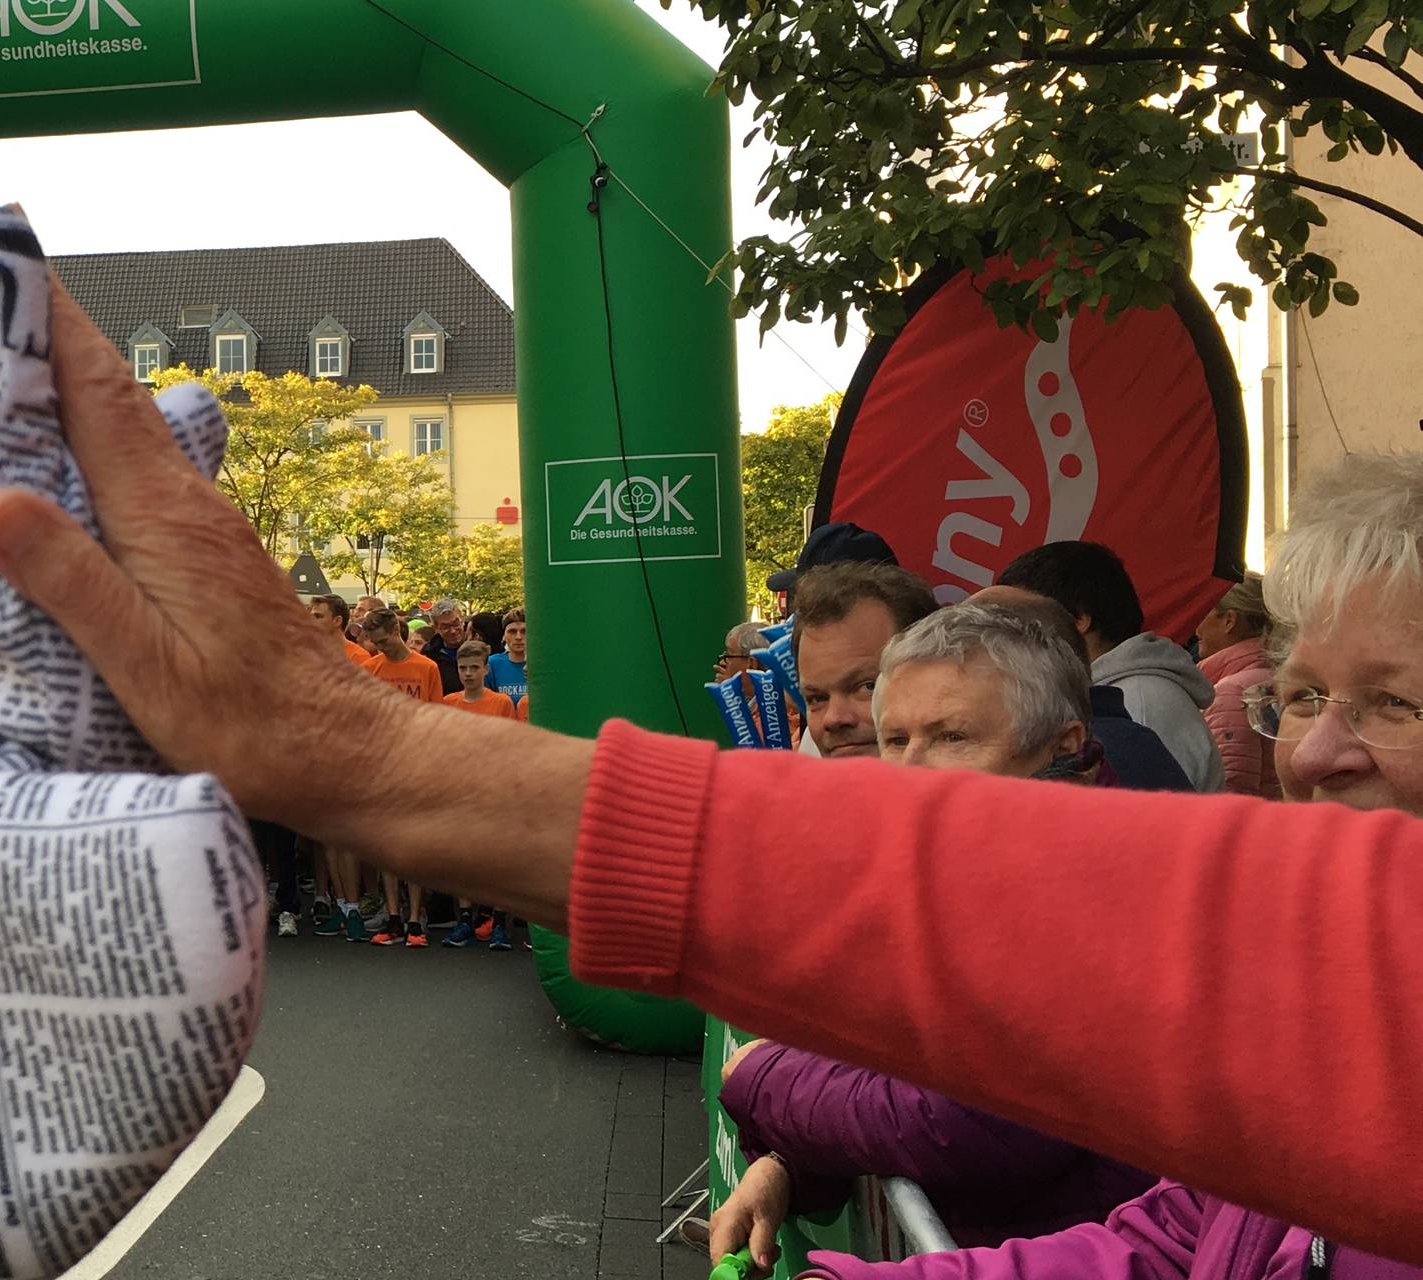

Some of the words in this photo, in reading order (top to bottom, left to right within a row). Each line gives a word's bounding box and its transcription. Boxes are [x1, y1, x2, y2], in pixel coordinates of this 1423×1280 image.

[573, 474, 695, 526] AOK
[570, 529, 587, 540] Die
[590, 525, 697, 540] Gesundheitskasse.
[720, 684, 754, 745] Anzeiger
[761, 677, 782, 743] Anzeiger
